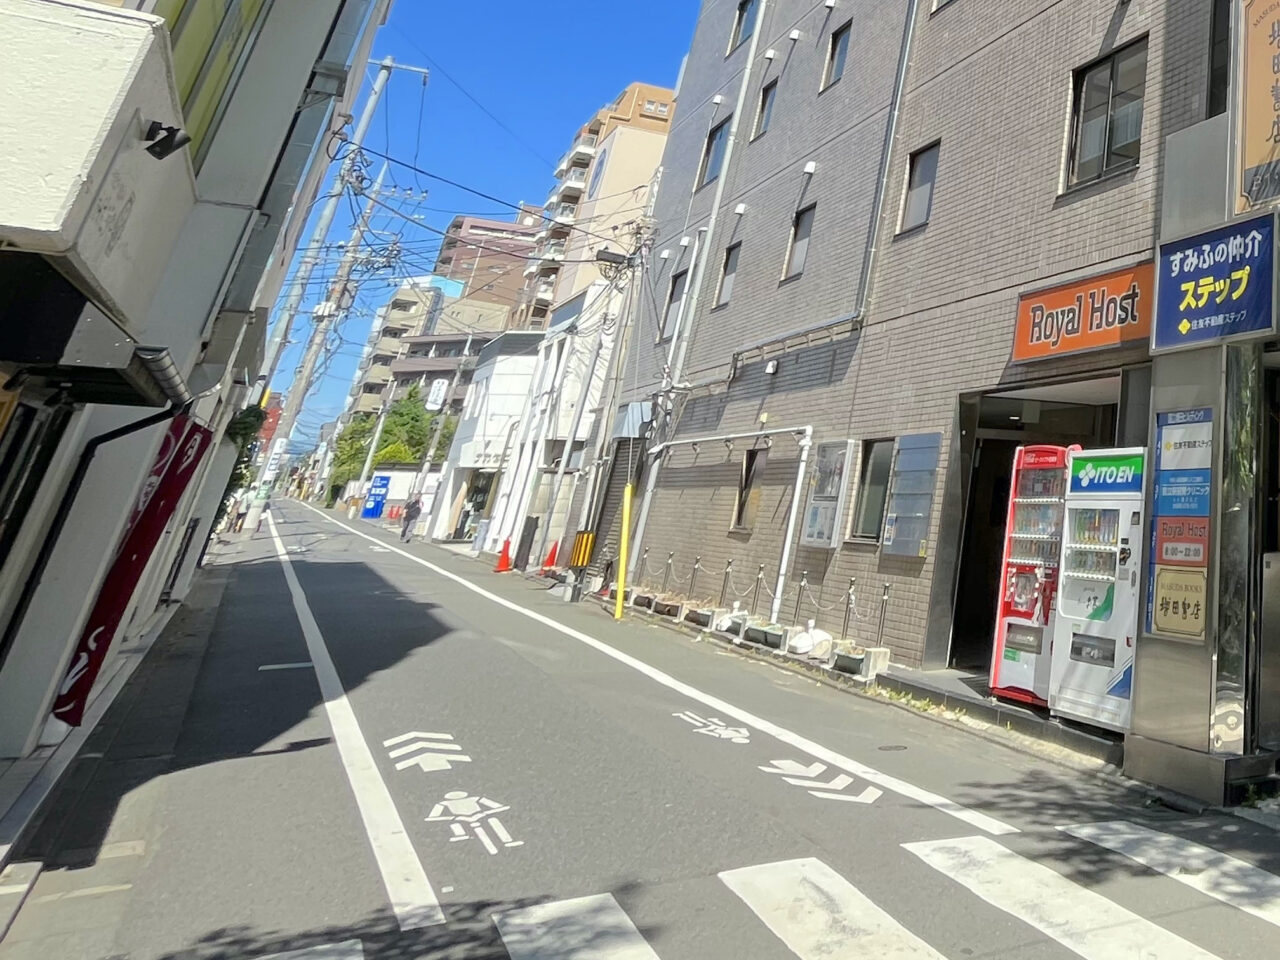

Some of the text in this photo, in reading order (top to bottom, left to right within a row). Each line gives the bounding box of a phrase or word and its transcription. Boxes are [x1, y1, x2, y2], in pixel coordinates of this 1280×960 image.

[1170, 229, 1263, 278] すみふの仲介
[1178, 265, 1251, 312] ステップ
[1029, 281, 1141, 347] Royal Host
[1192, 309, 1247, 331] 住友不動産ステップ
[1094, 465, 1135, 484] ITO EN
[1162, 522, 1207, 538] Royal Host
